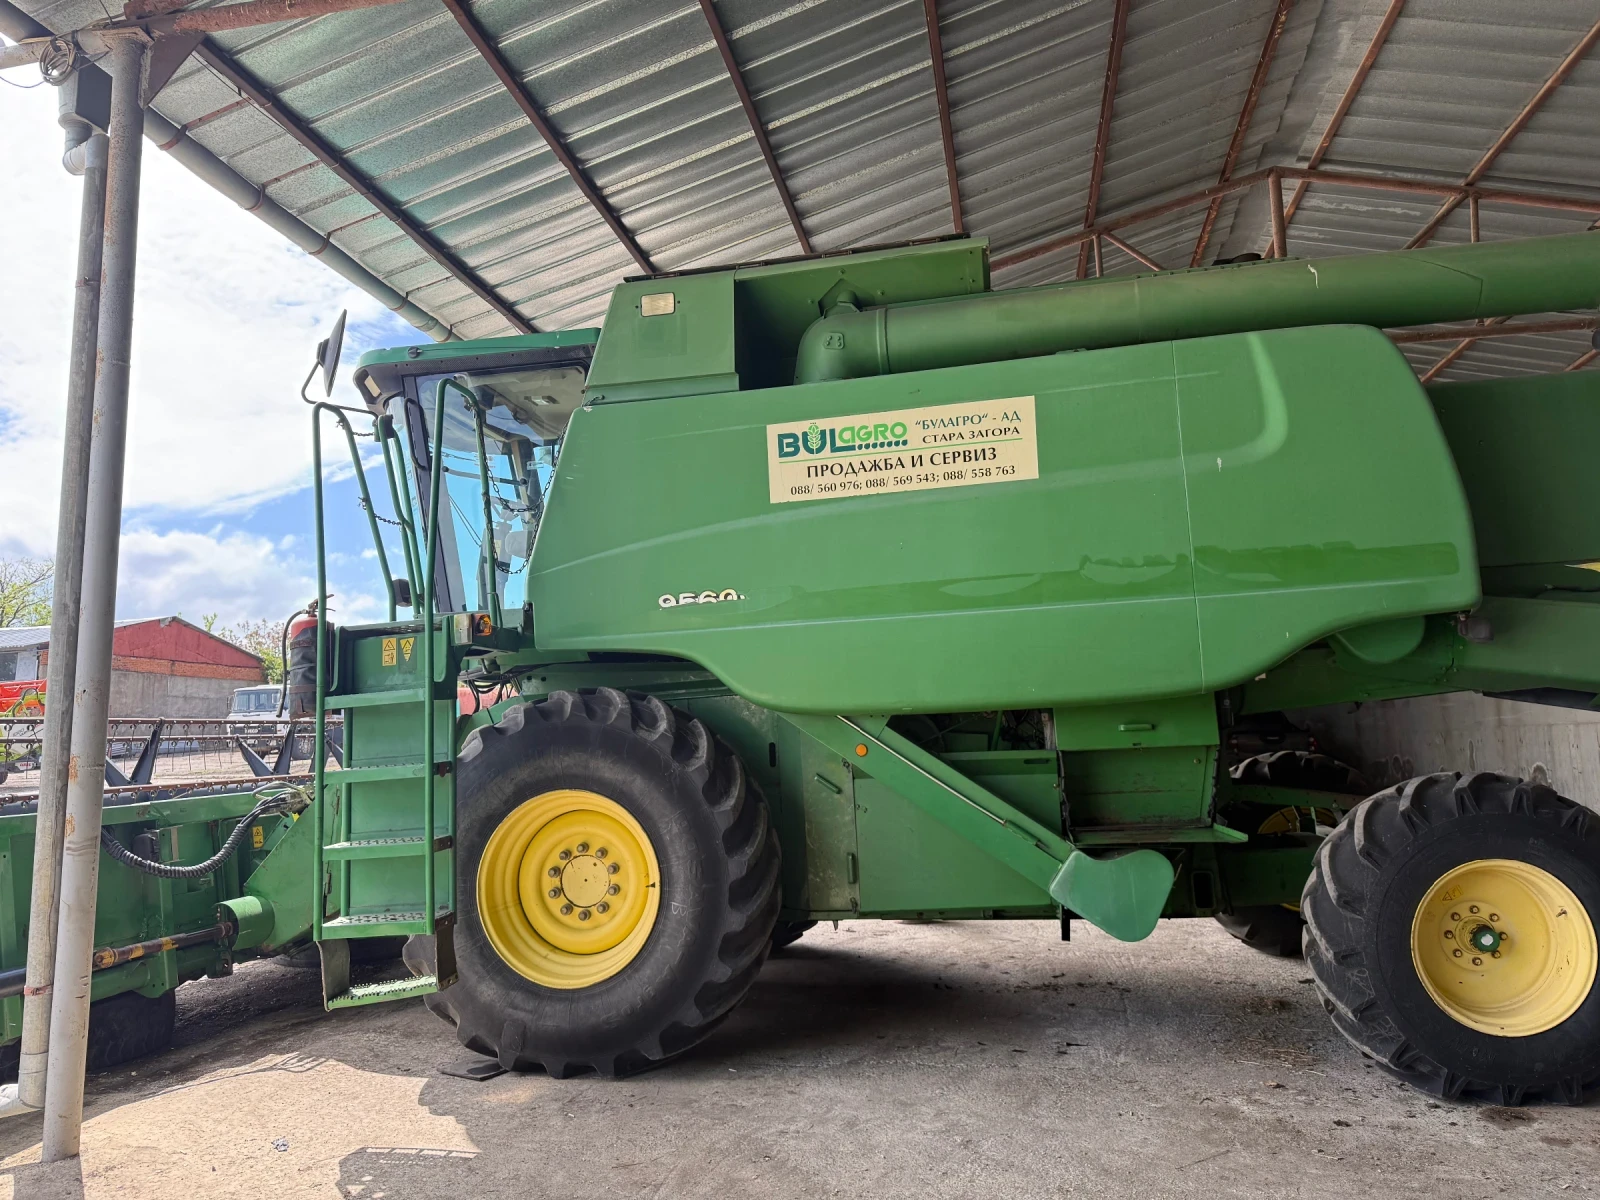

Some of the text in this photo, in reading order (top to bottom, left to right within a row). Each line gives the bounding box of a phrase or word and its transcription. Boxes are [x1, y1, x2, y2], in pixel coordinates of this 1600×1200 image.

[1001, 410, 1022, 423] АД
[922, 426, 1020, 444] СТАРА ЗАГОРА
[806, 447, 997, 479] ПРОДАЖБА И СЕРВИЗ
[790, 464, 1016, 496] 088/ 560 976; 088/ 569 543; 088/ 558 763
